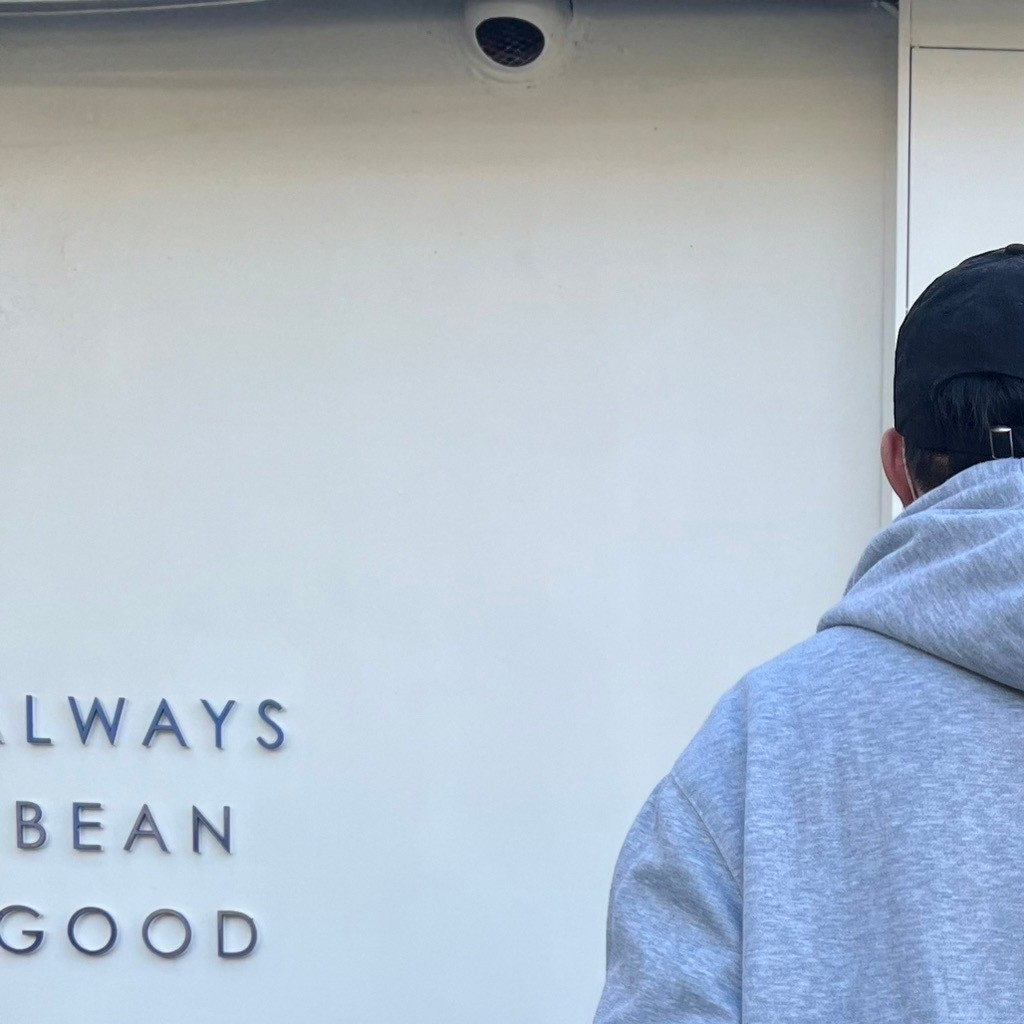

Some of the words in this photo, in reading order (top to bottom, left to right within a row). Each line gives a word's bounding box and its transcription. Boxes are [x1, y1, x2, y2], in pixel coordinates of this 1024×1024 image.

[0, 694, 287, 751] LWAYS
[15, 800, 233, 854] BEAN
[0, 904, 259, 959] GOOD
